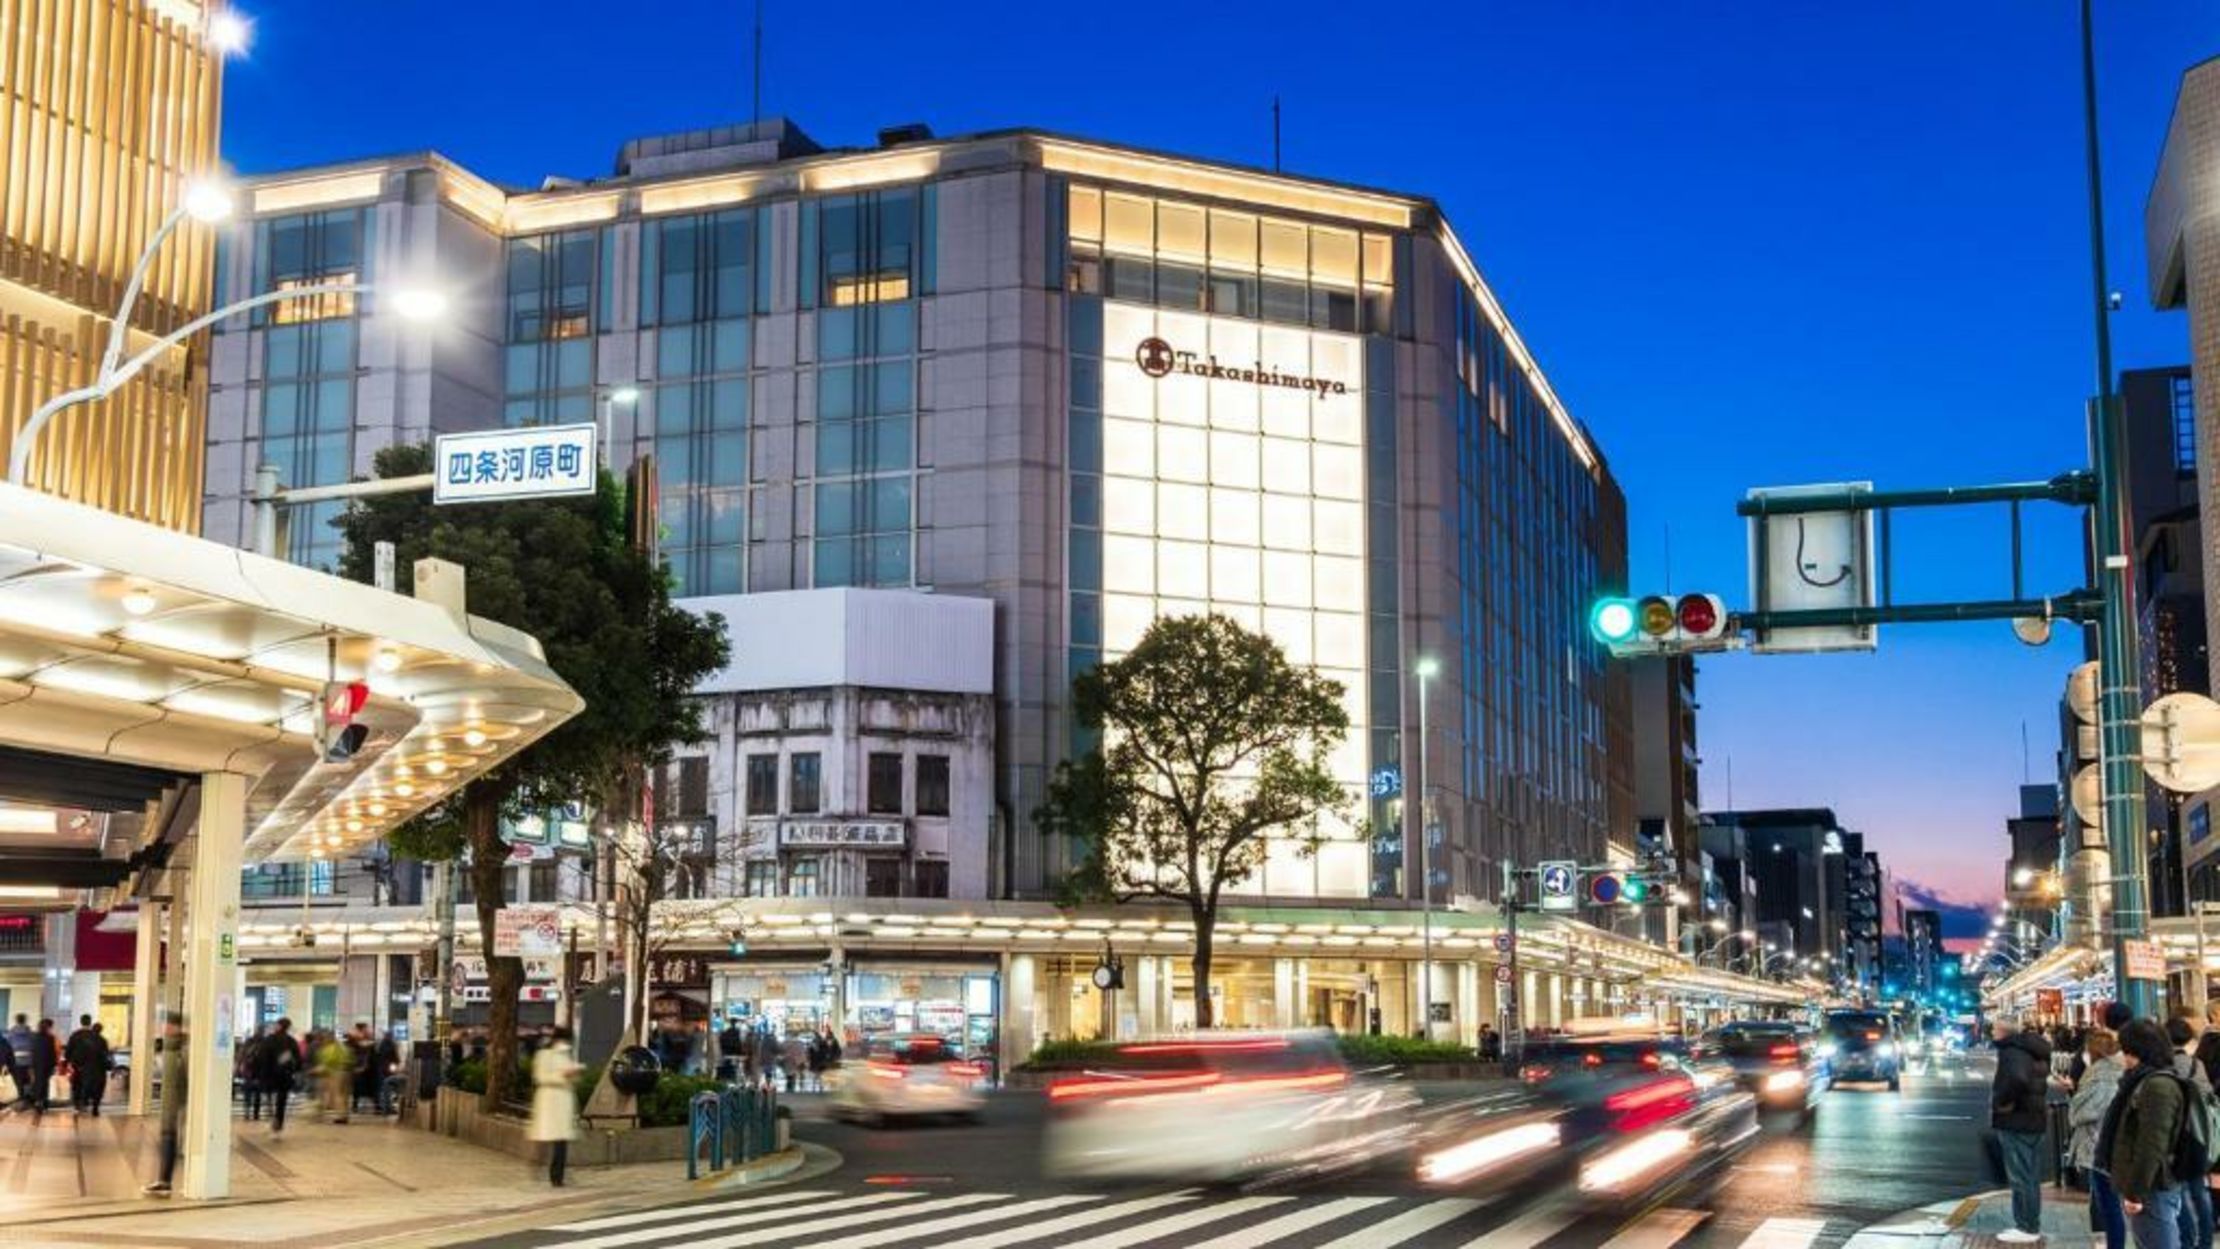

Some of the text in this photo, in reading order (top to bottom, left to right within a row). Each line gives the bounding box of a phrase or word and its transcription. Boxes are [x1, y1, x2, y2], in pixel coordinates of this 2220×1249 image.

[1176, 351, 1346, 399] Takashimaya
[449, 443, 582, 484] 四条河原町
